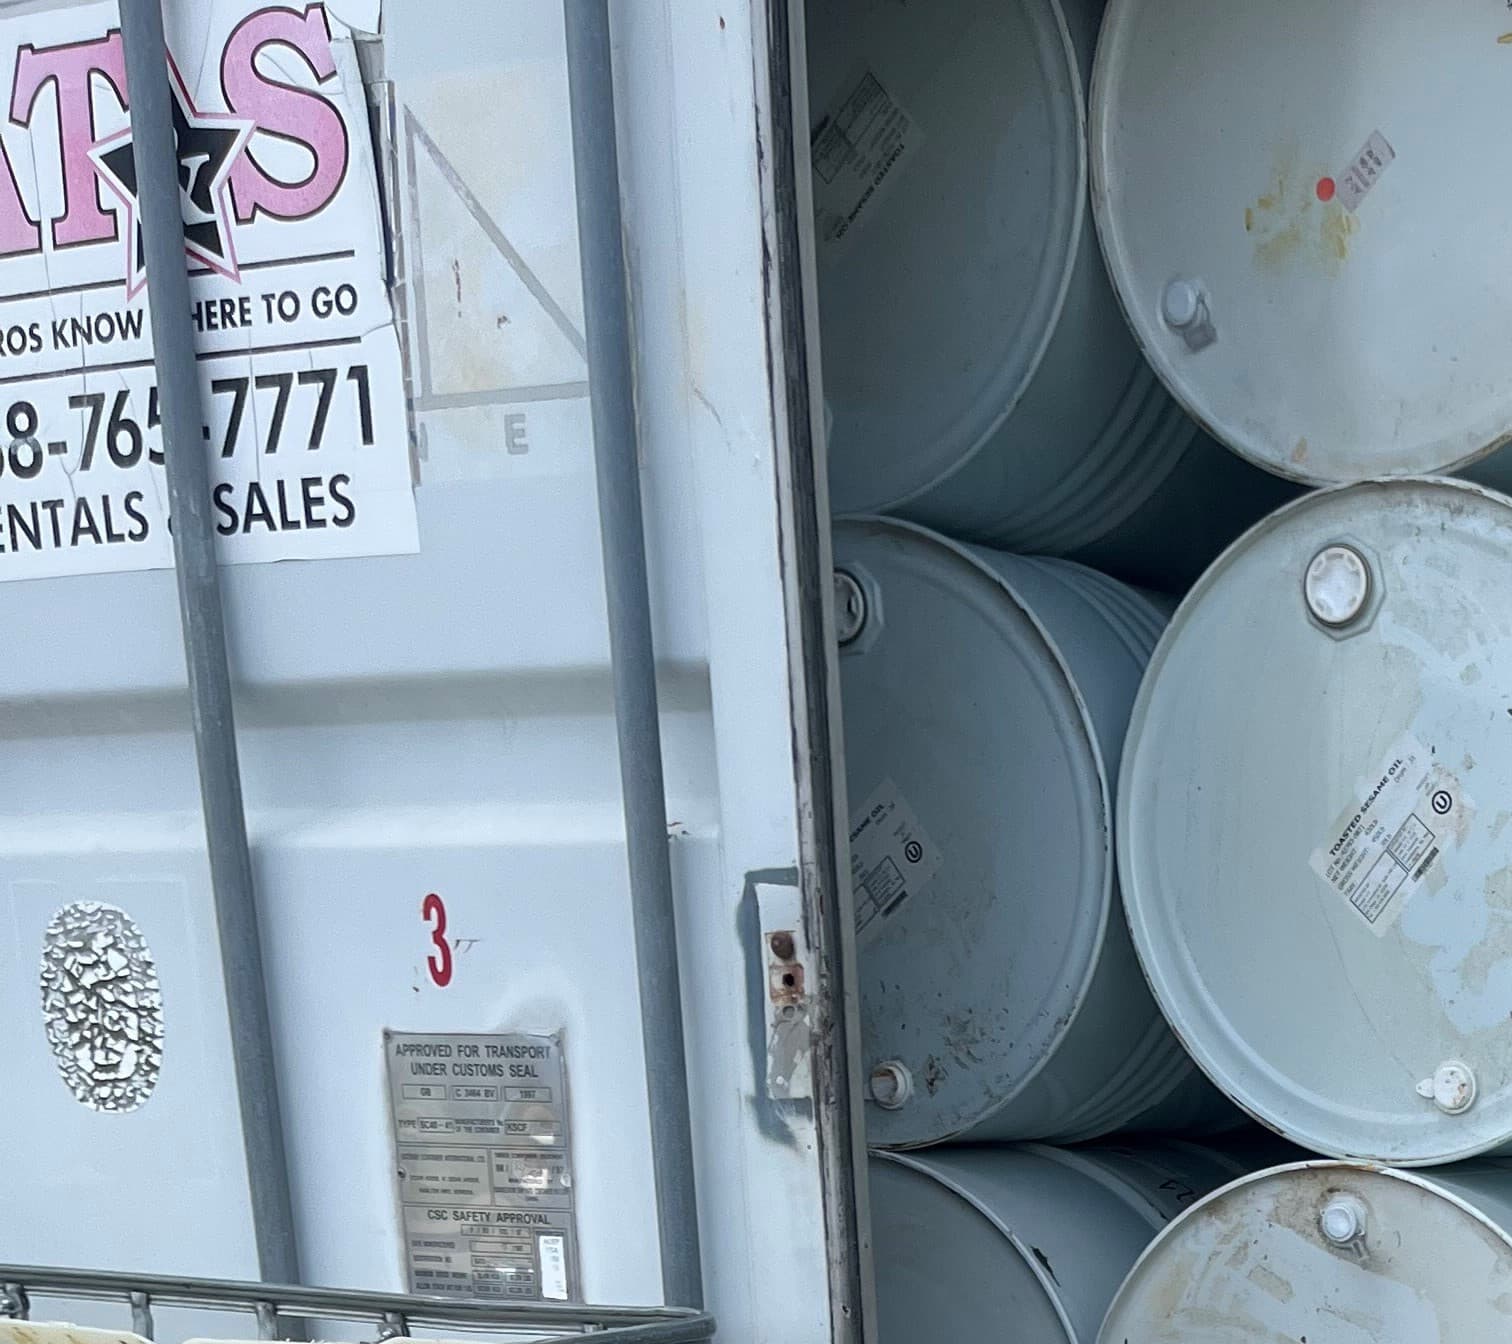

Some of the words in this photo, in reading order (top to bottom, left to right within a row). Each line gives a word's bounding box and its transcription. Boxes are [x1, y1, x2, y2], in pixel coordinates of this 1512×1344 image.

[52, 310, 143, 350] KNOW
[261, 291, 300, 324] TO
[312, 283, 358, 319] GO
[0, 491, 149, 552] NTALS
[214, 474, 356, 536] SALES
[1329, 814, 1361, 856] TOASTED
[1361, 776, 1389, 813] SESAME
[1388, 759, 1403, 775] OIL
[423, 893, 453, 987] 3
[395, 1044, 452, 1058] APPROVED
[457, 1045, 480, 1058] FOR
[485, 1045, 550, 1060] TRANSPORT
[410, 1062, 447, 1076] UNDER
[452, 1063, 504, 1077] CUSTOMS
[509, 1064, 539, 1078] SEAL
[398, 1119, 416, 1129] TYPE
[428, 1209, 448, 1221] CSC
[452, 1210, 492, 1223] SAFETY
[496, 1212, 551, 1225] APPROVAL
